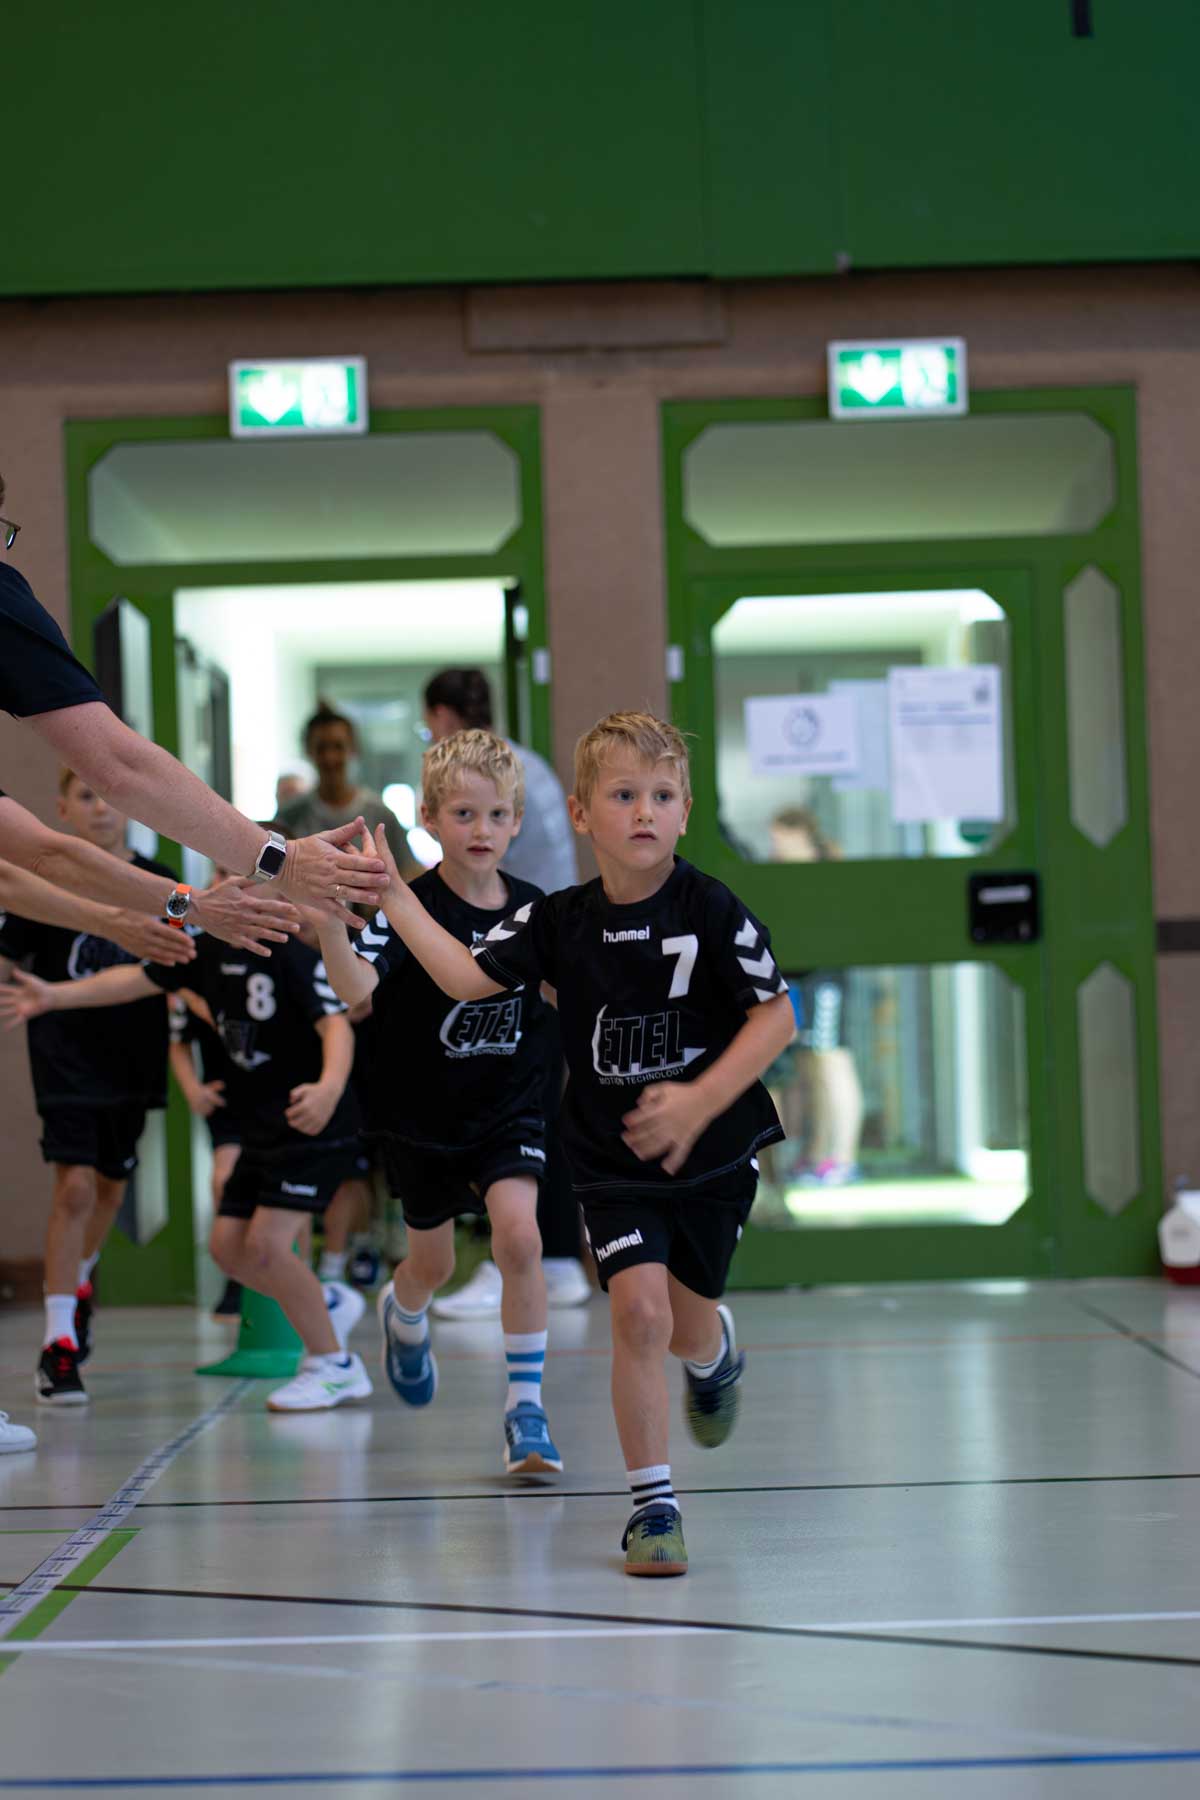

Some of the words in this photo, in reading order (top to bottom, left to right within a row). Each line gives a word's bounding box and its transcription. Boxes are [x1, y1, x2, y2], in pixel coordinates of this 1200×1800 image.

[603, 926, 650, 943] hummel
[662, 934, 699, 999] 7
[246, 973, 276, 1021] 8
[625, 1067, 685, 1086] TECHNOLOGY
[595, 1228, 643, 1263] hummel
